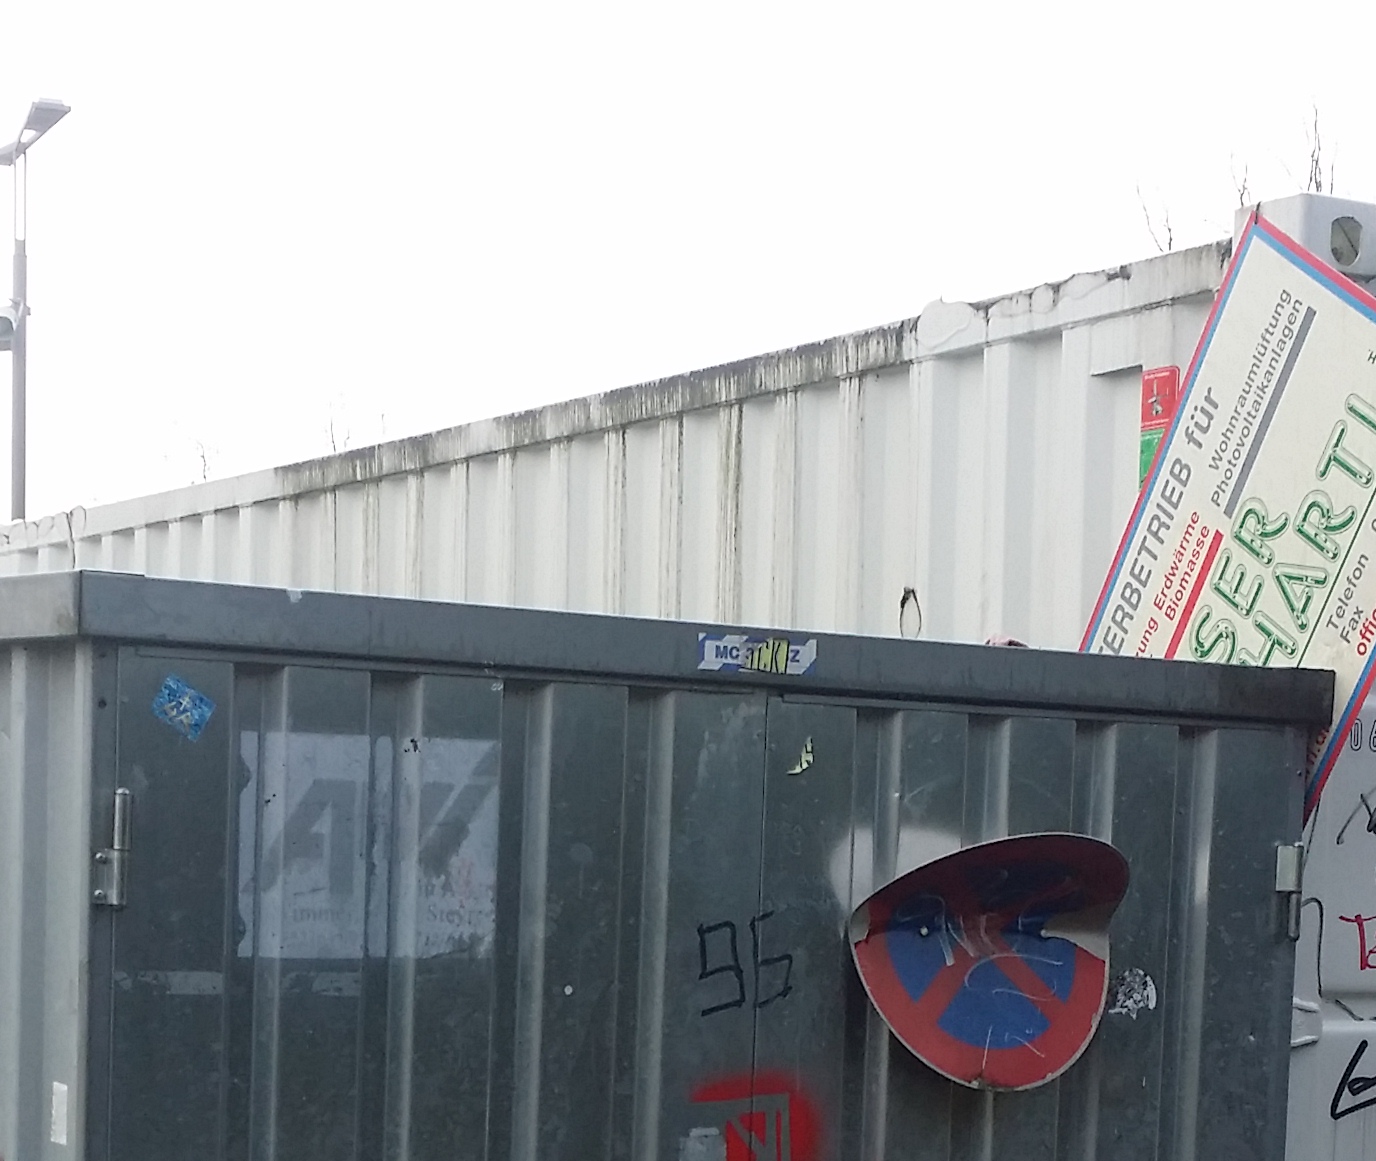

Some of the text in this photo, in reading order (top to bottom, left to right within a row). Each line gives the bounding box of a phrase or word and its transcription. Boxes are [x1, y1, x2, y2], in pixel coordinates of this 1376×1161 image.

[1184, 385, 1220, 452] für
[1208, 288, 1292, 473] Wohnraumlüftung
[1210, 299, 1304, 508] Photovoltaikanlagen
[1153, 510, 1201, 611] Erdwärme
[1164, 525, 1211, 622] Biomasse
[1326, 552, 1370, 631] Telefon
[1338, 604, 1366, 646] Fax
